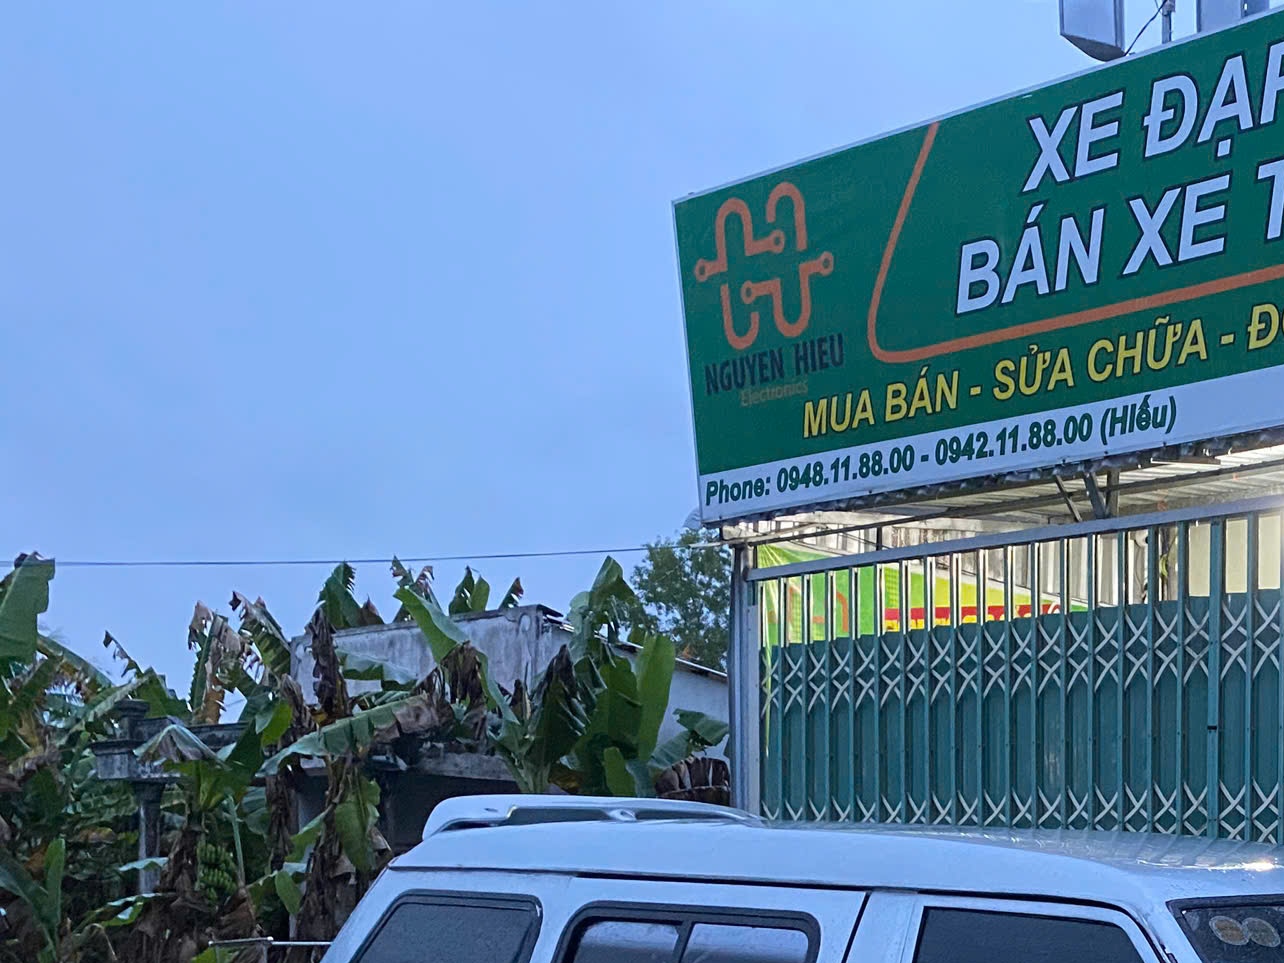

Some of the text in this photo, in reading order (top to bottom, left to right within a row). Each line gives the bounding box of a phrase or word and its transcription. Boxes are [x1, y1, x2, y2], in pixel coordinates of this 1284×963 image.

[1023, 91, 1125, 193] XE
[956, 204, 1104, 316] BÁN
[1122, 174, 1232, 277] XE
[704, 332, 844, 396] NGUYEN HIEU
[802, 393, 874, 439] MUA
[884, 371, 959, 425] BÁN
[992, 344, 1074, 402] SỬA
[1087, 315, 1208, 383] CHỮA
[705, 477, 770, 506] Phone:
[776, 445, 915, 493] 0948.11.88.00
[935, 413, 1093, 466] 0942.11.88.00
